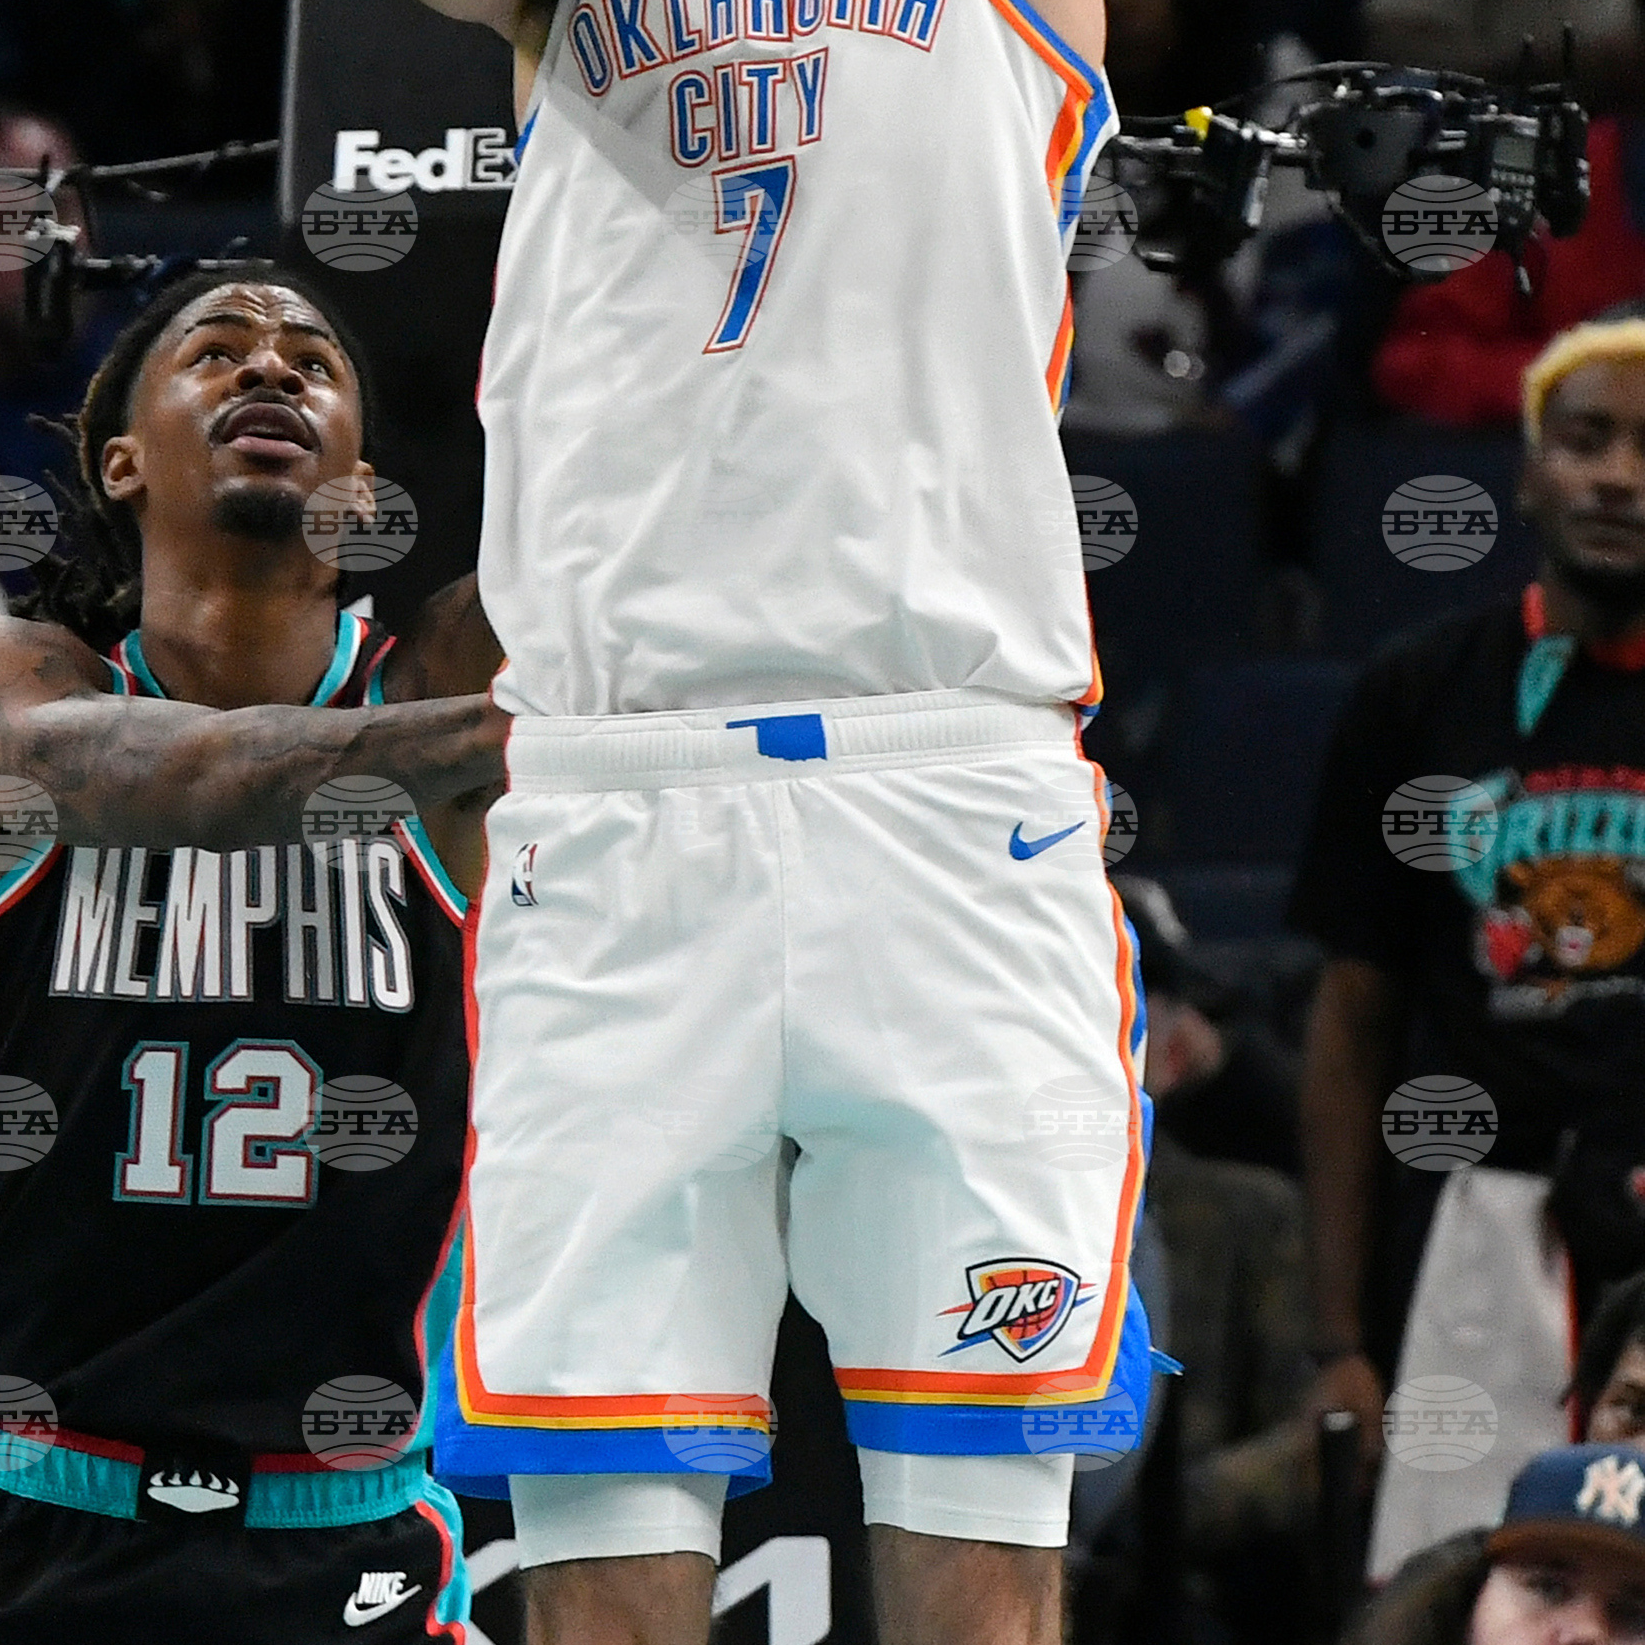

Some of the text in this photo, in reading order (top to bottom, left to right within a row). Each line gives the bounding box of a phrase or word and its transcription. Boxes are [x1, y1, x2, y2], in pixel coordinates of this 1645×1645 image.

[668, 47, 828, 169] CITY
[704, 156, 798, 355] 7
[48, 837, 414, 1014] MEMPHIS
[113, 1038, 324, 1209] 12
[959, 1277, 1061, 1338] OKC
[356, 1570, 411, 1605] NIKE
